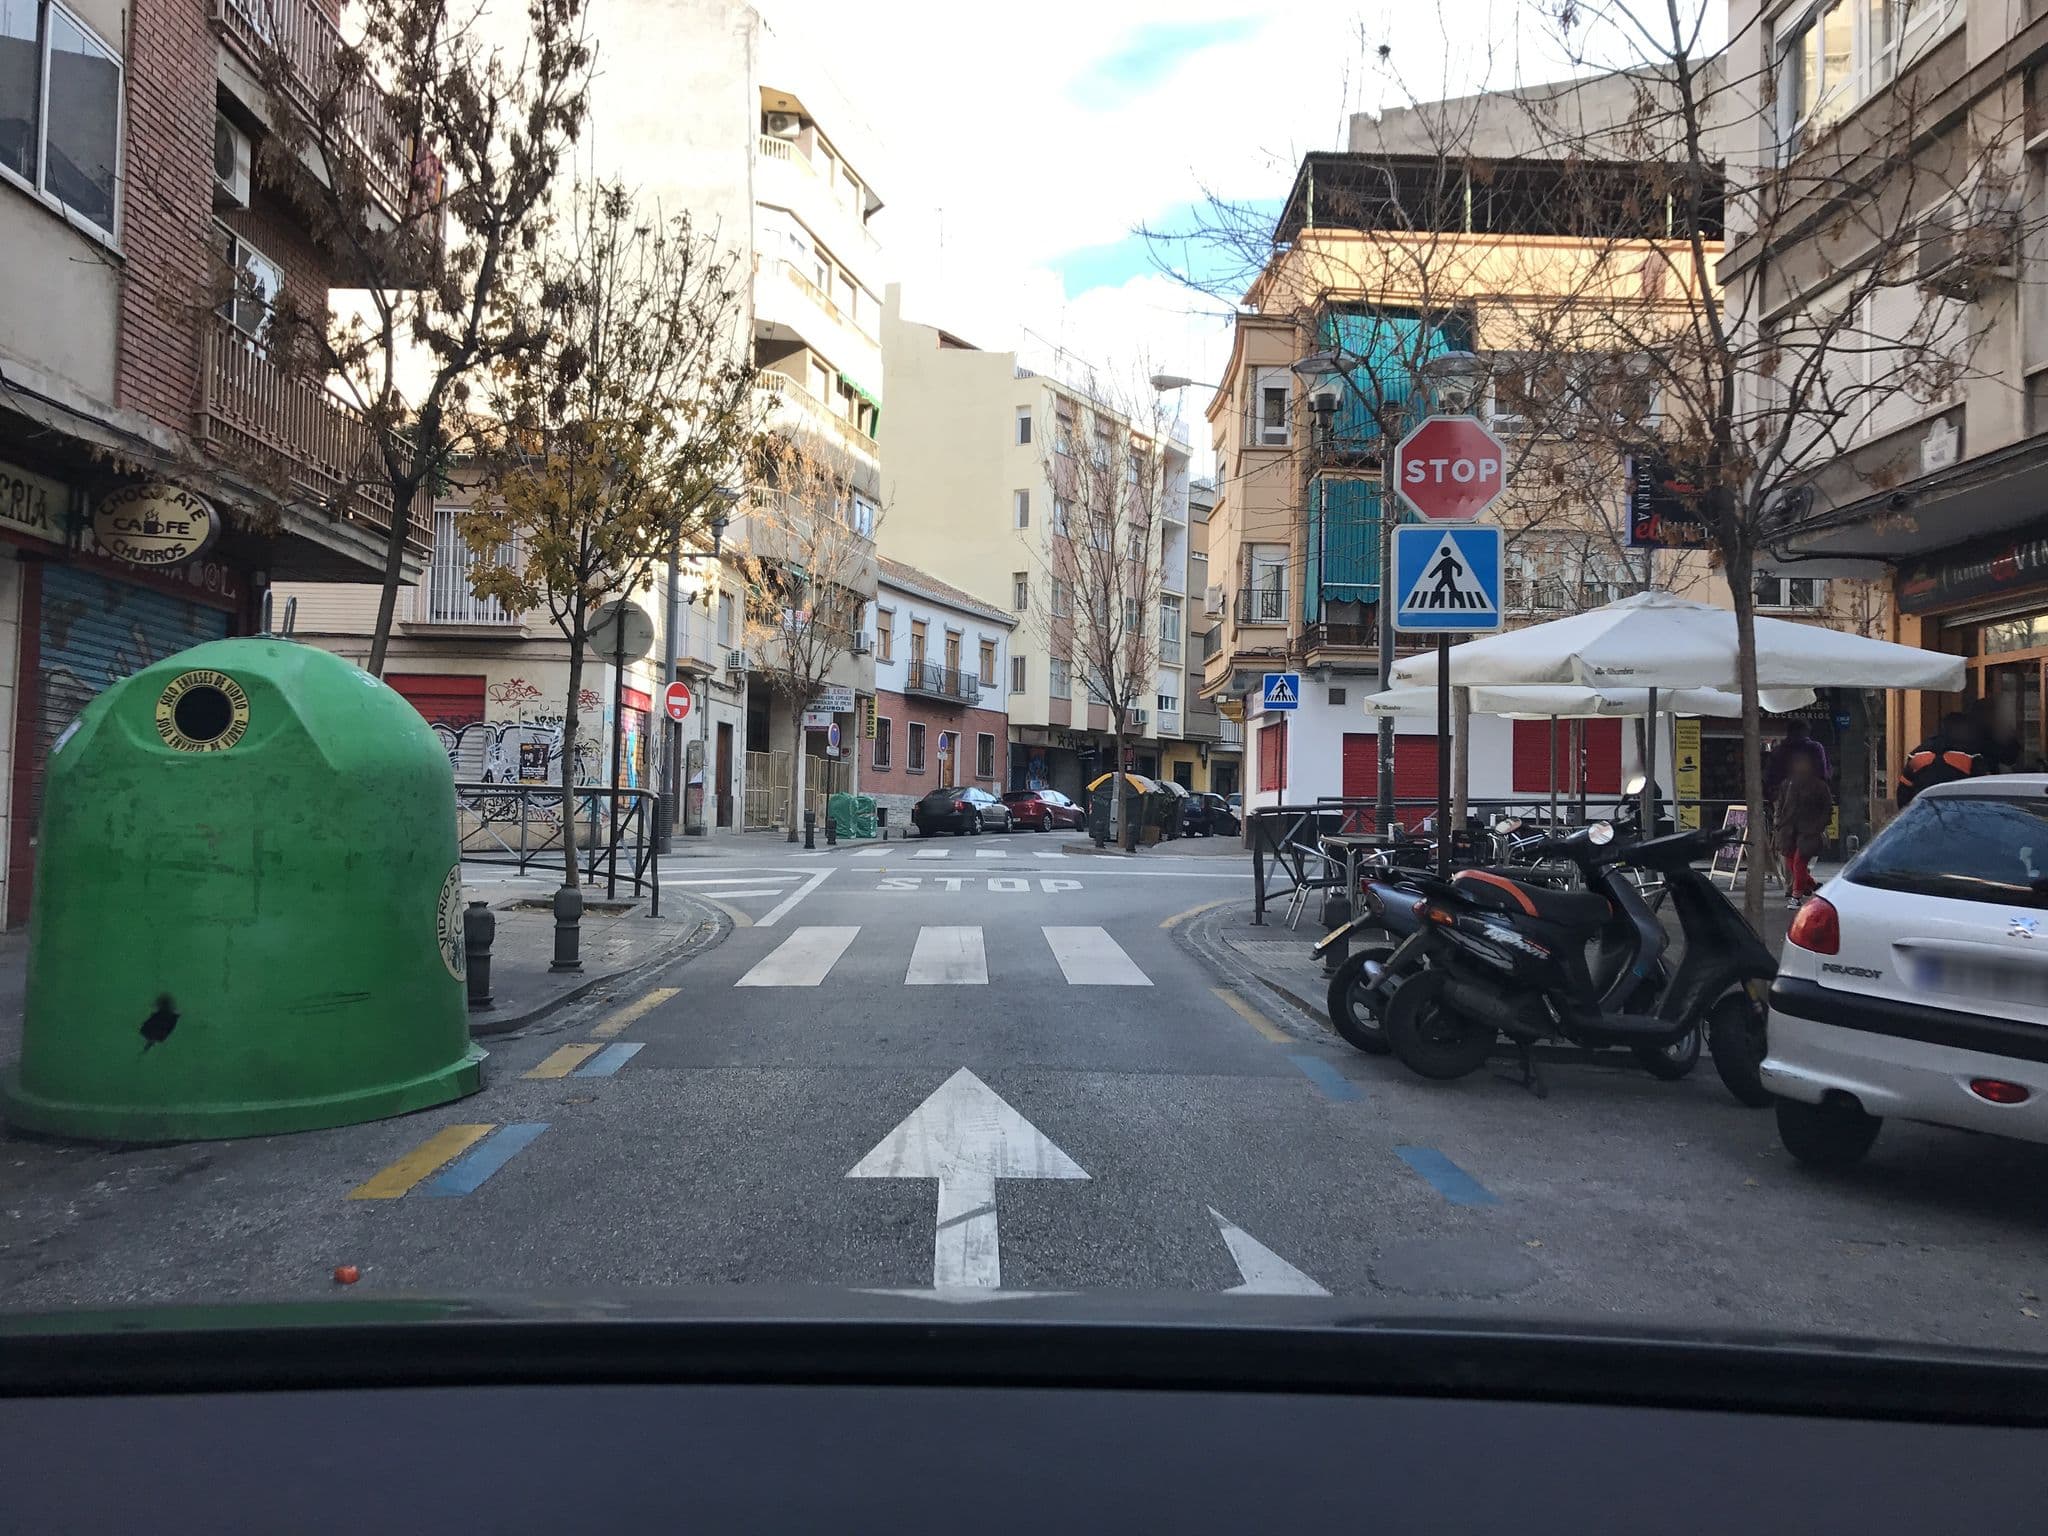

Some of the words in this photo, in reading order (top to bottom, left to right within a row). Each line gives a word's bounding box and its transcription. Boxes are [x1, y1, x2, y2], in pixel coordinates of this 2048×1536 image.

[1405, 459, 1499, 483] STOP
[100, 484, 207, 522] CHOCOATE
[112, 539, 187, 563] CHURROS
[160, 686, 179, 708] SOLO
[176, 671, 214, 690] ENVASES
[213, 674, 227, 688] DE
[224, 682, 248, 710] VIDRIO
[875, 877, 1084, 894] STOP
[439, 885, 451, 950] VIDRIO
[1822, 963, 1883, 979] PEUGEOT
